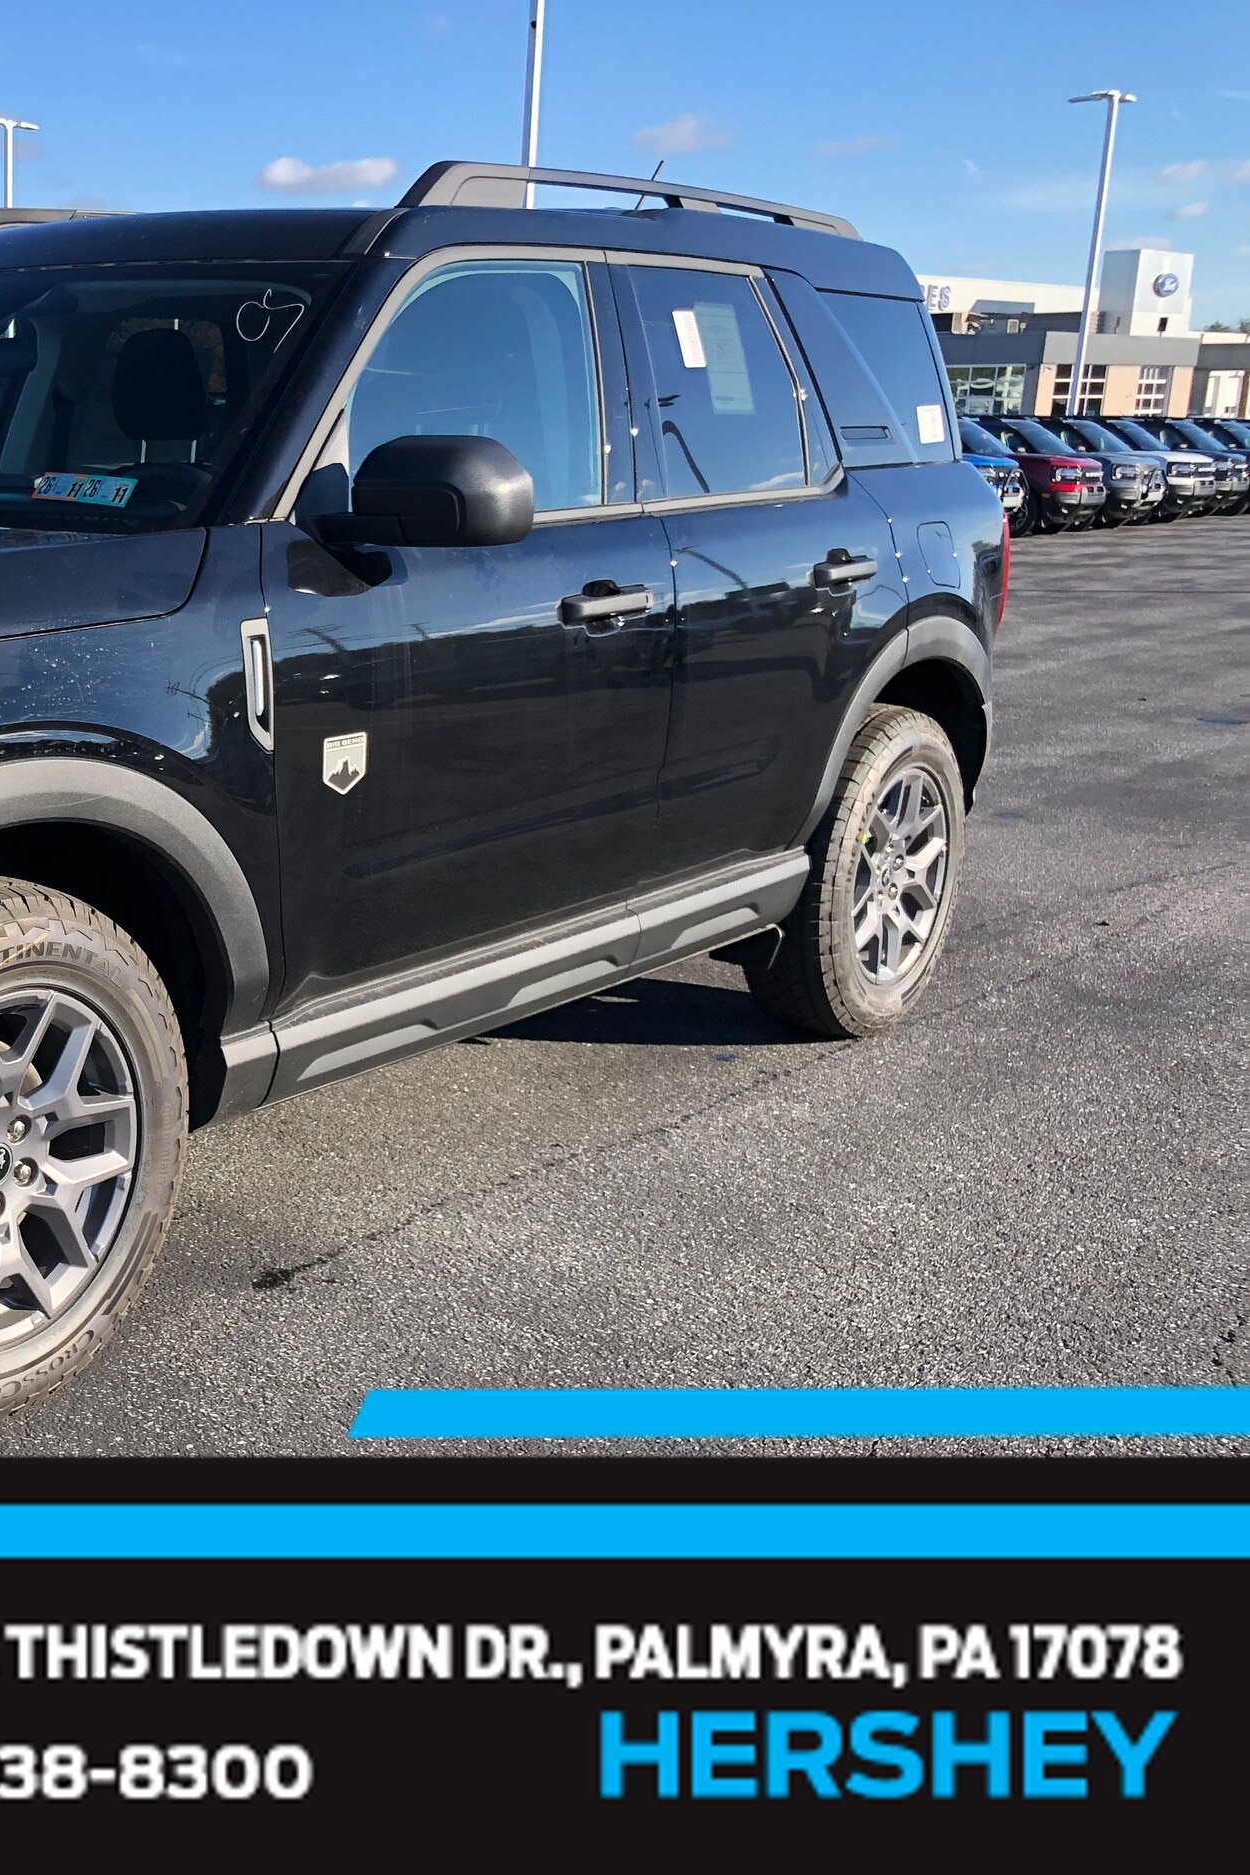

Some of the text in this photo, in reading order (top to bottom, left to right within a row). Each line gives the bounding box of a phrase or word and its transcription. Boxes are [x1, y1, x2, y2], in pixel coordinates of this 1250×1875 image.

[38, 477, 84, 498] 26 11
[82, 479, 129, 503] 26 11
[326, 737, 364, 749] BIG BEND
